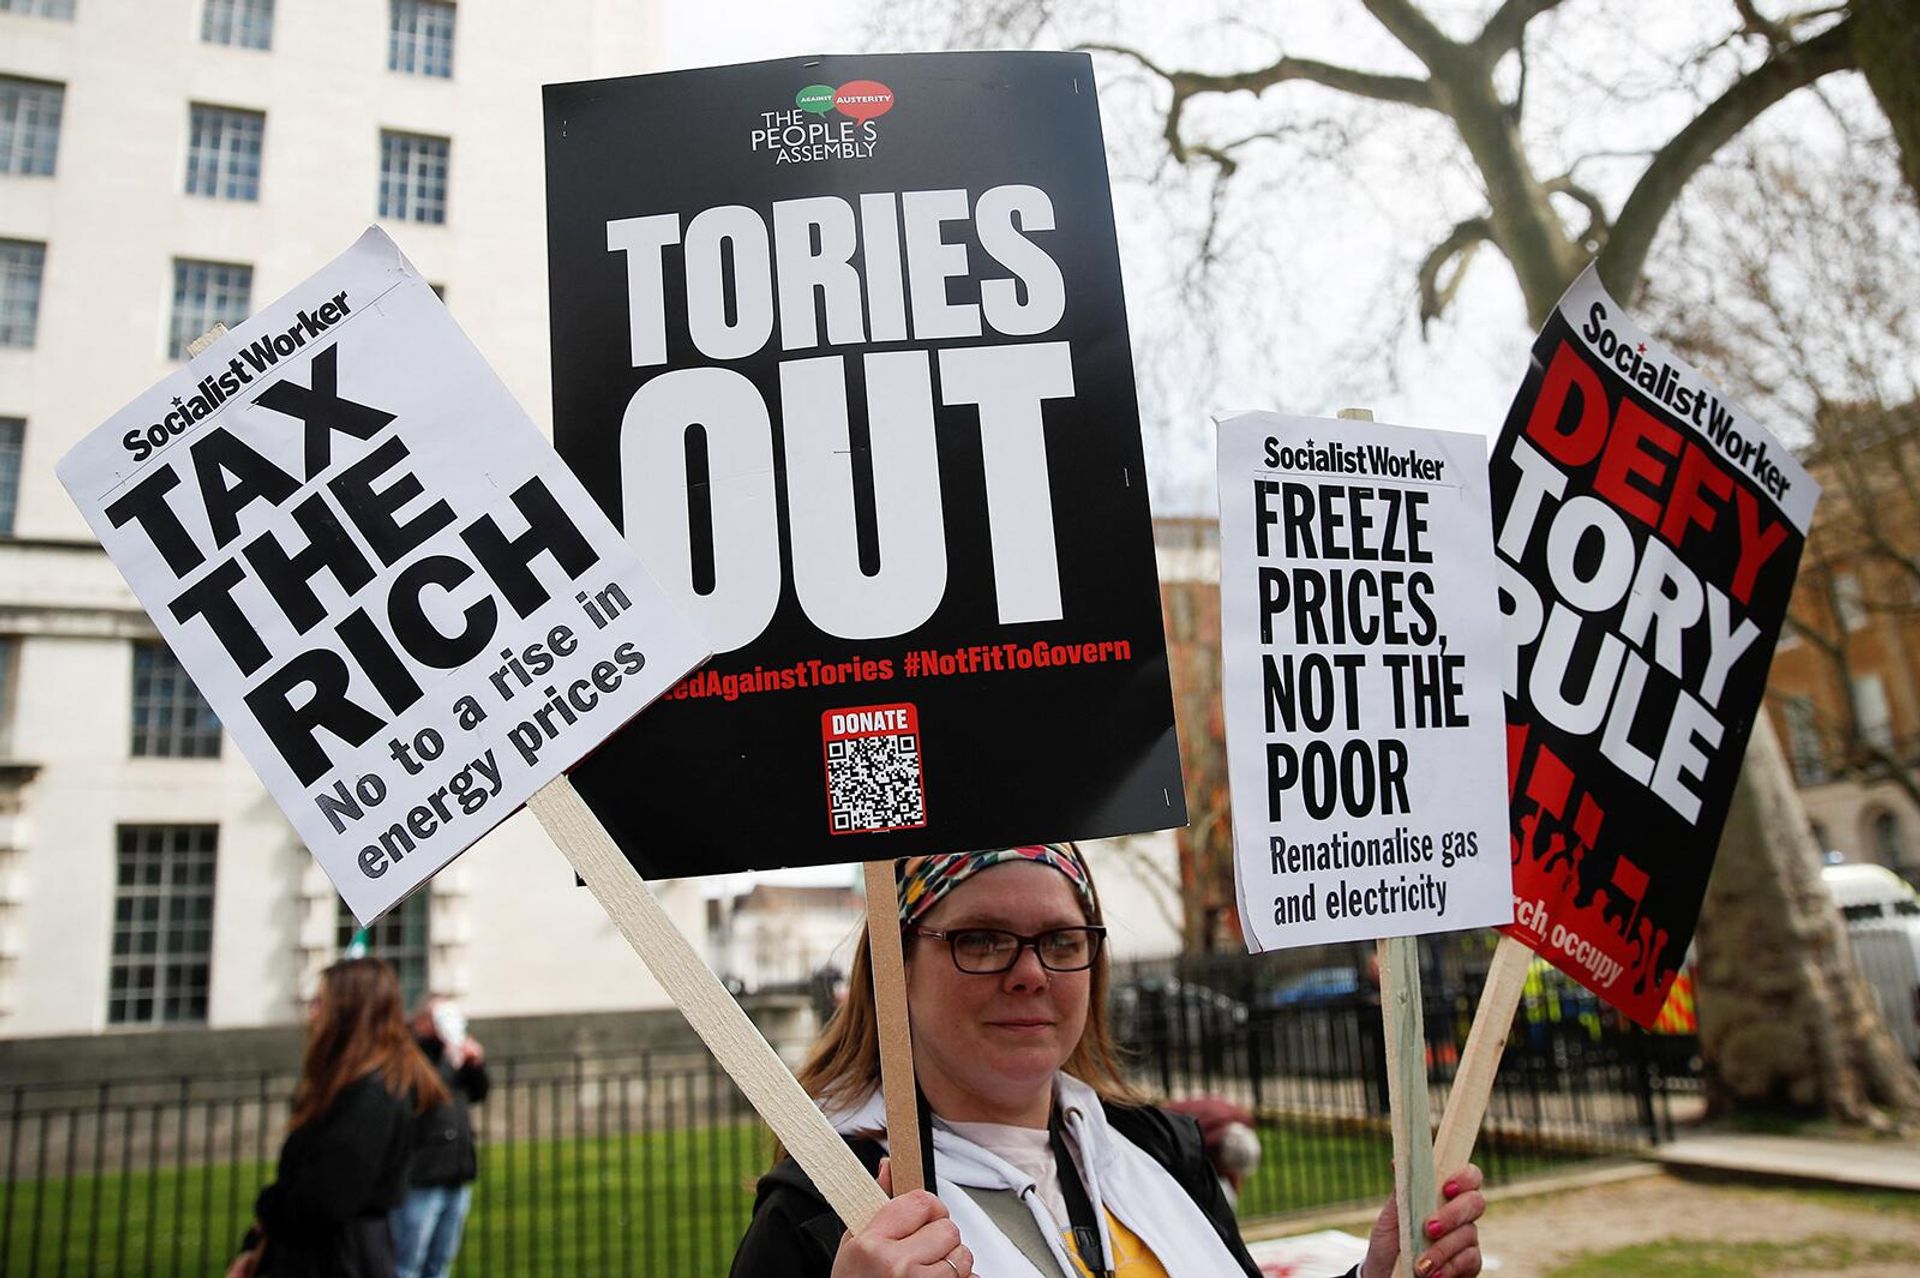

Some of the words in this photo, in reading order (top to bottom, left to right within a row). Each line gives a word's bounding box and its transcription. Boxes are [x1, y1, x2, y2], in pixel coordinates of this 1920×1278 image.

[761, 109, 803, 128] THE
[836, 94, 891, 104] AUSTERITY
[776, 142, 877, 165] ASSEMBLY
[607, 185, 1066, 367] TORIES
[104, 342, 398, 579] TAX
[620, 341, 1076, 654] OUT
[1526, 339, 1789, 607] DEFY
[167, 434, 458, 677] THE
[1254, 480, 1433, 563] FREEZE
[1258, 566, 1447, 656] PRICES,
[1497, 434, 1762, 710] TORY
[243, 475, 600, 788] RICH
[663, 655, 894, 701] edAgainstTories
[904, 640, 1131, 677] #NotFitToGovern
[314, 772, 387, 833] No
[391, 727, 445, 776] to
[452, 695, 487, 731] a
[488, 627, 578, 701] rise
[577, 581, 632, 629] in
[832, 709, 908, 735] DONATE
[1263, 653, 1365, 733] NOT
[1383, 653, 1469, 729] THE
[357, 746, 503, 879] energy
[507, 641, 646, 767] prices
[1267, 739, 1411, 822] POOR
[1270, 827, 1433, 875] Renationalise
[1441, 829, 1478, 865] gas
[1273, 883, 1315, 926] and
[1325, 872, 1447, 920] electricity
[1551, 924, 1623, 988] occupy
